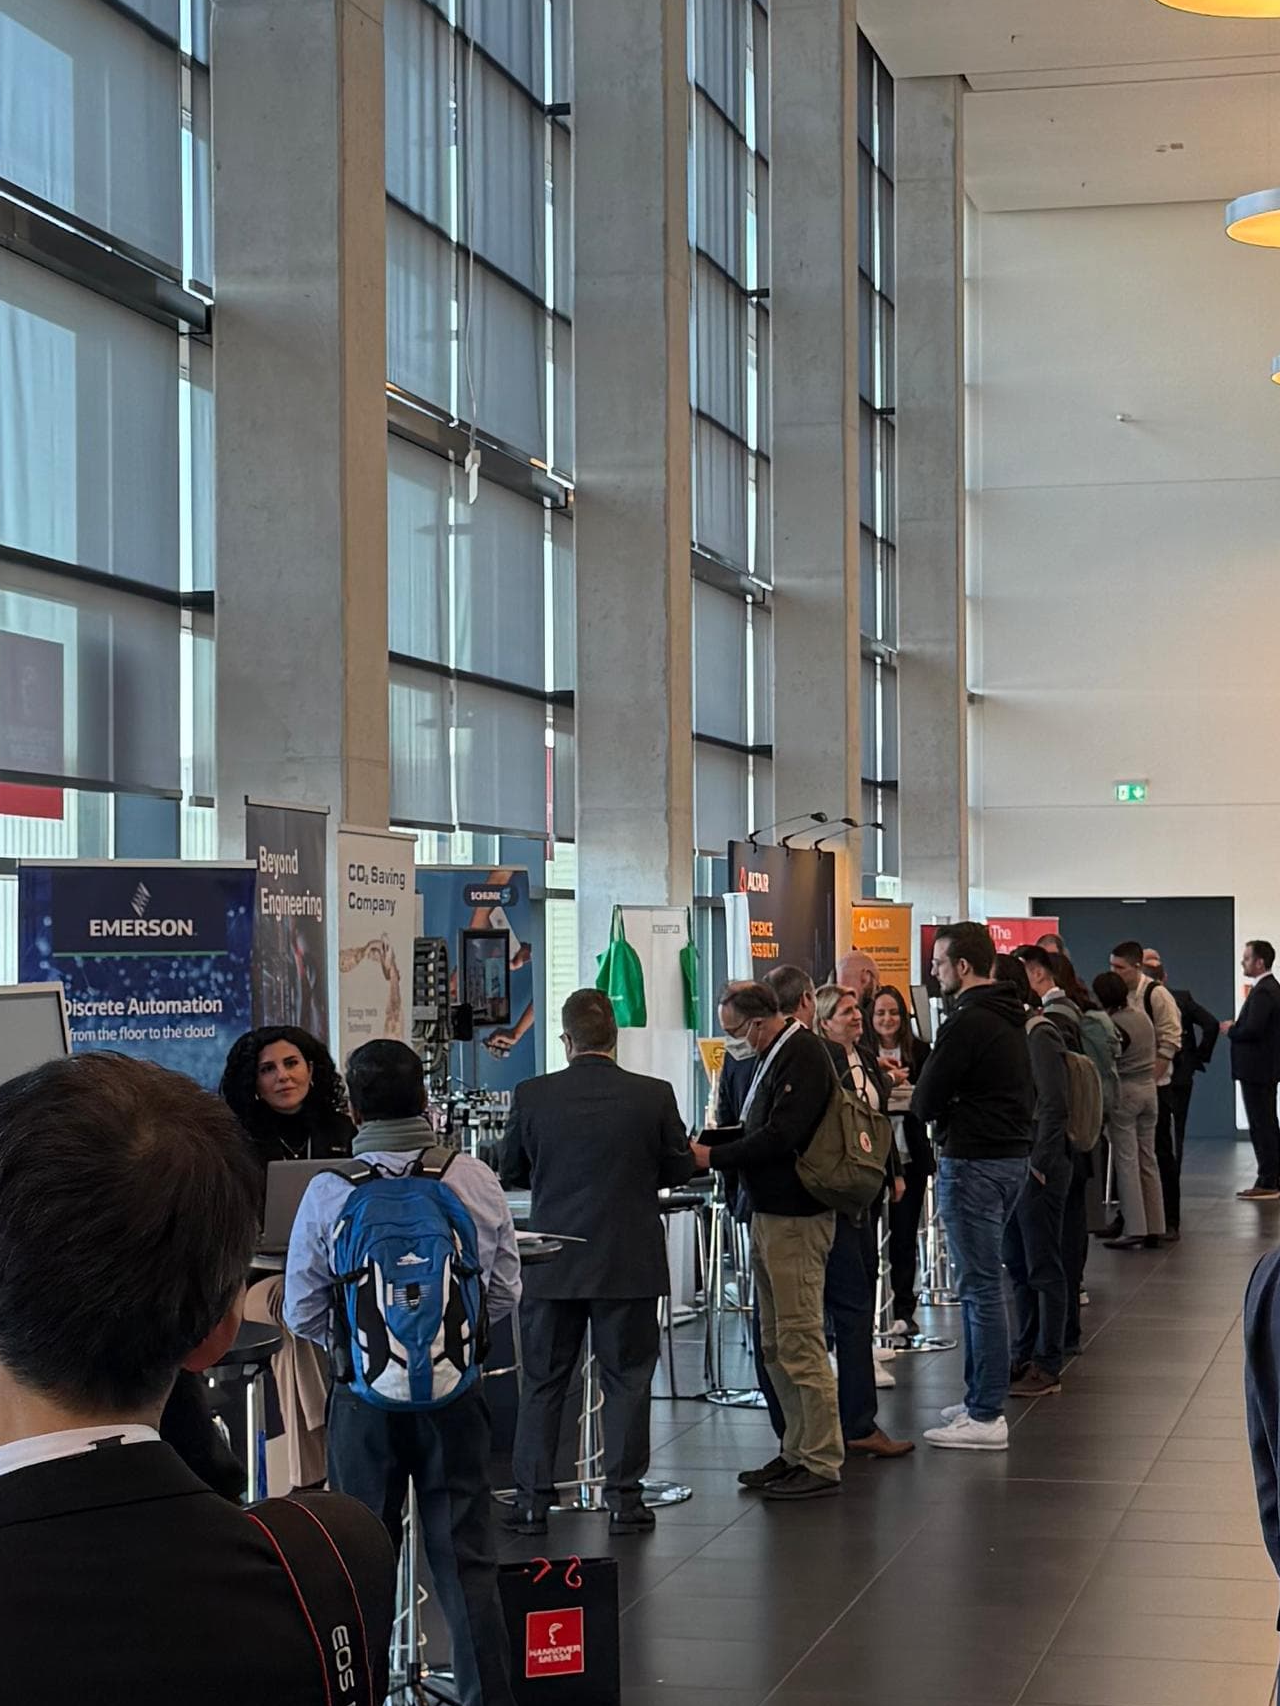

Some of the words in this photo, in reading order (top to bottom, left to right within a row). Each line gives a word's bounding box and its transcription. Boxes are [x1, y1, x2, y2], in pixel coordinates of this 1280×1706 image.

[259, 846, 298, 879] Beyond
[371, 866, 405, 890] Saving
[748, 871, 769, 892] ALTAIR
[261, 888, 322, 922] Engineering
[348, 892, 396, 917] Company
[89, 919, 194, 937] EMERSON
[868, 917, 890, 929] ALTAIR
[991, 925, 1011, 941] The
[65, 998, 125, 1016] Discrete
[127, 995, 223, 1015] Automation
[70, 1027, 96, 1041] from
[98, 1027, 118, 1040] the
[120, 1025, 147, 1040] floor
[149, 1026, 160, 1039] to
[163, 1025, 182, 1038] the
[184, 1024, 216, 1038] cloud
[331, 1625, 356, 1692] EOS
